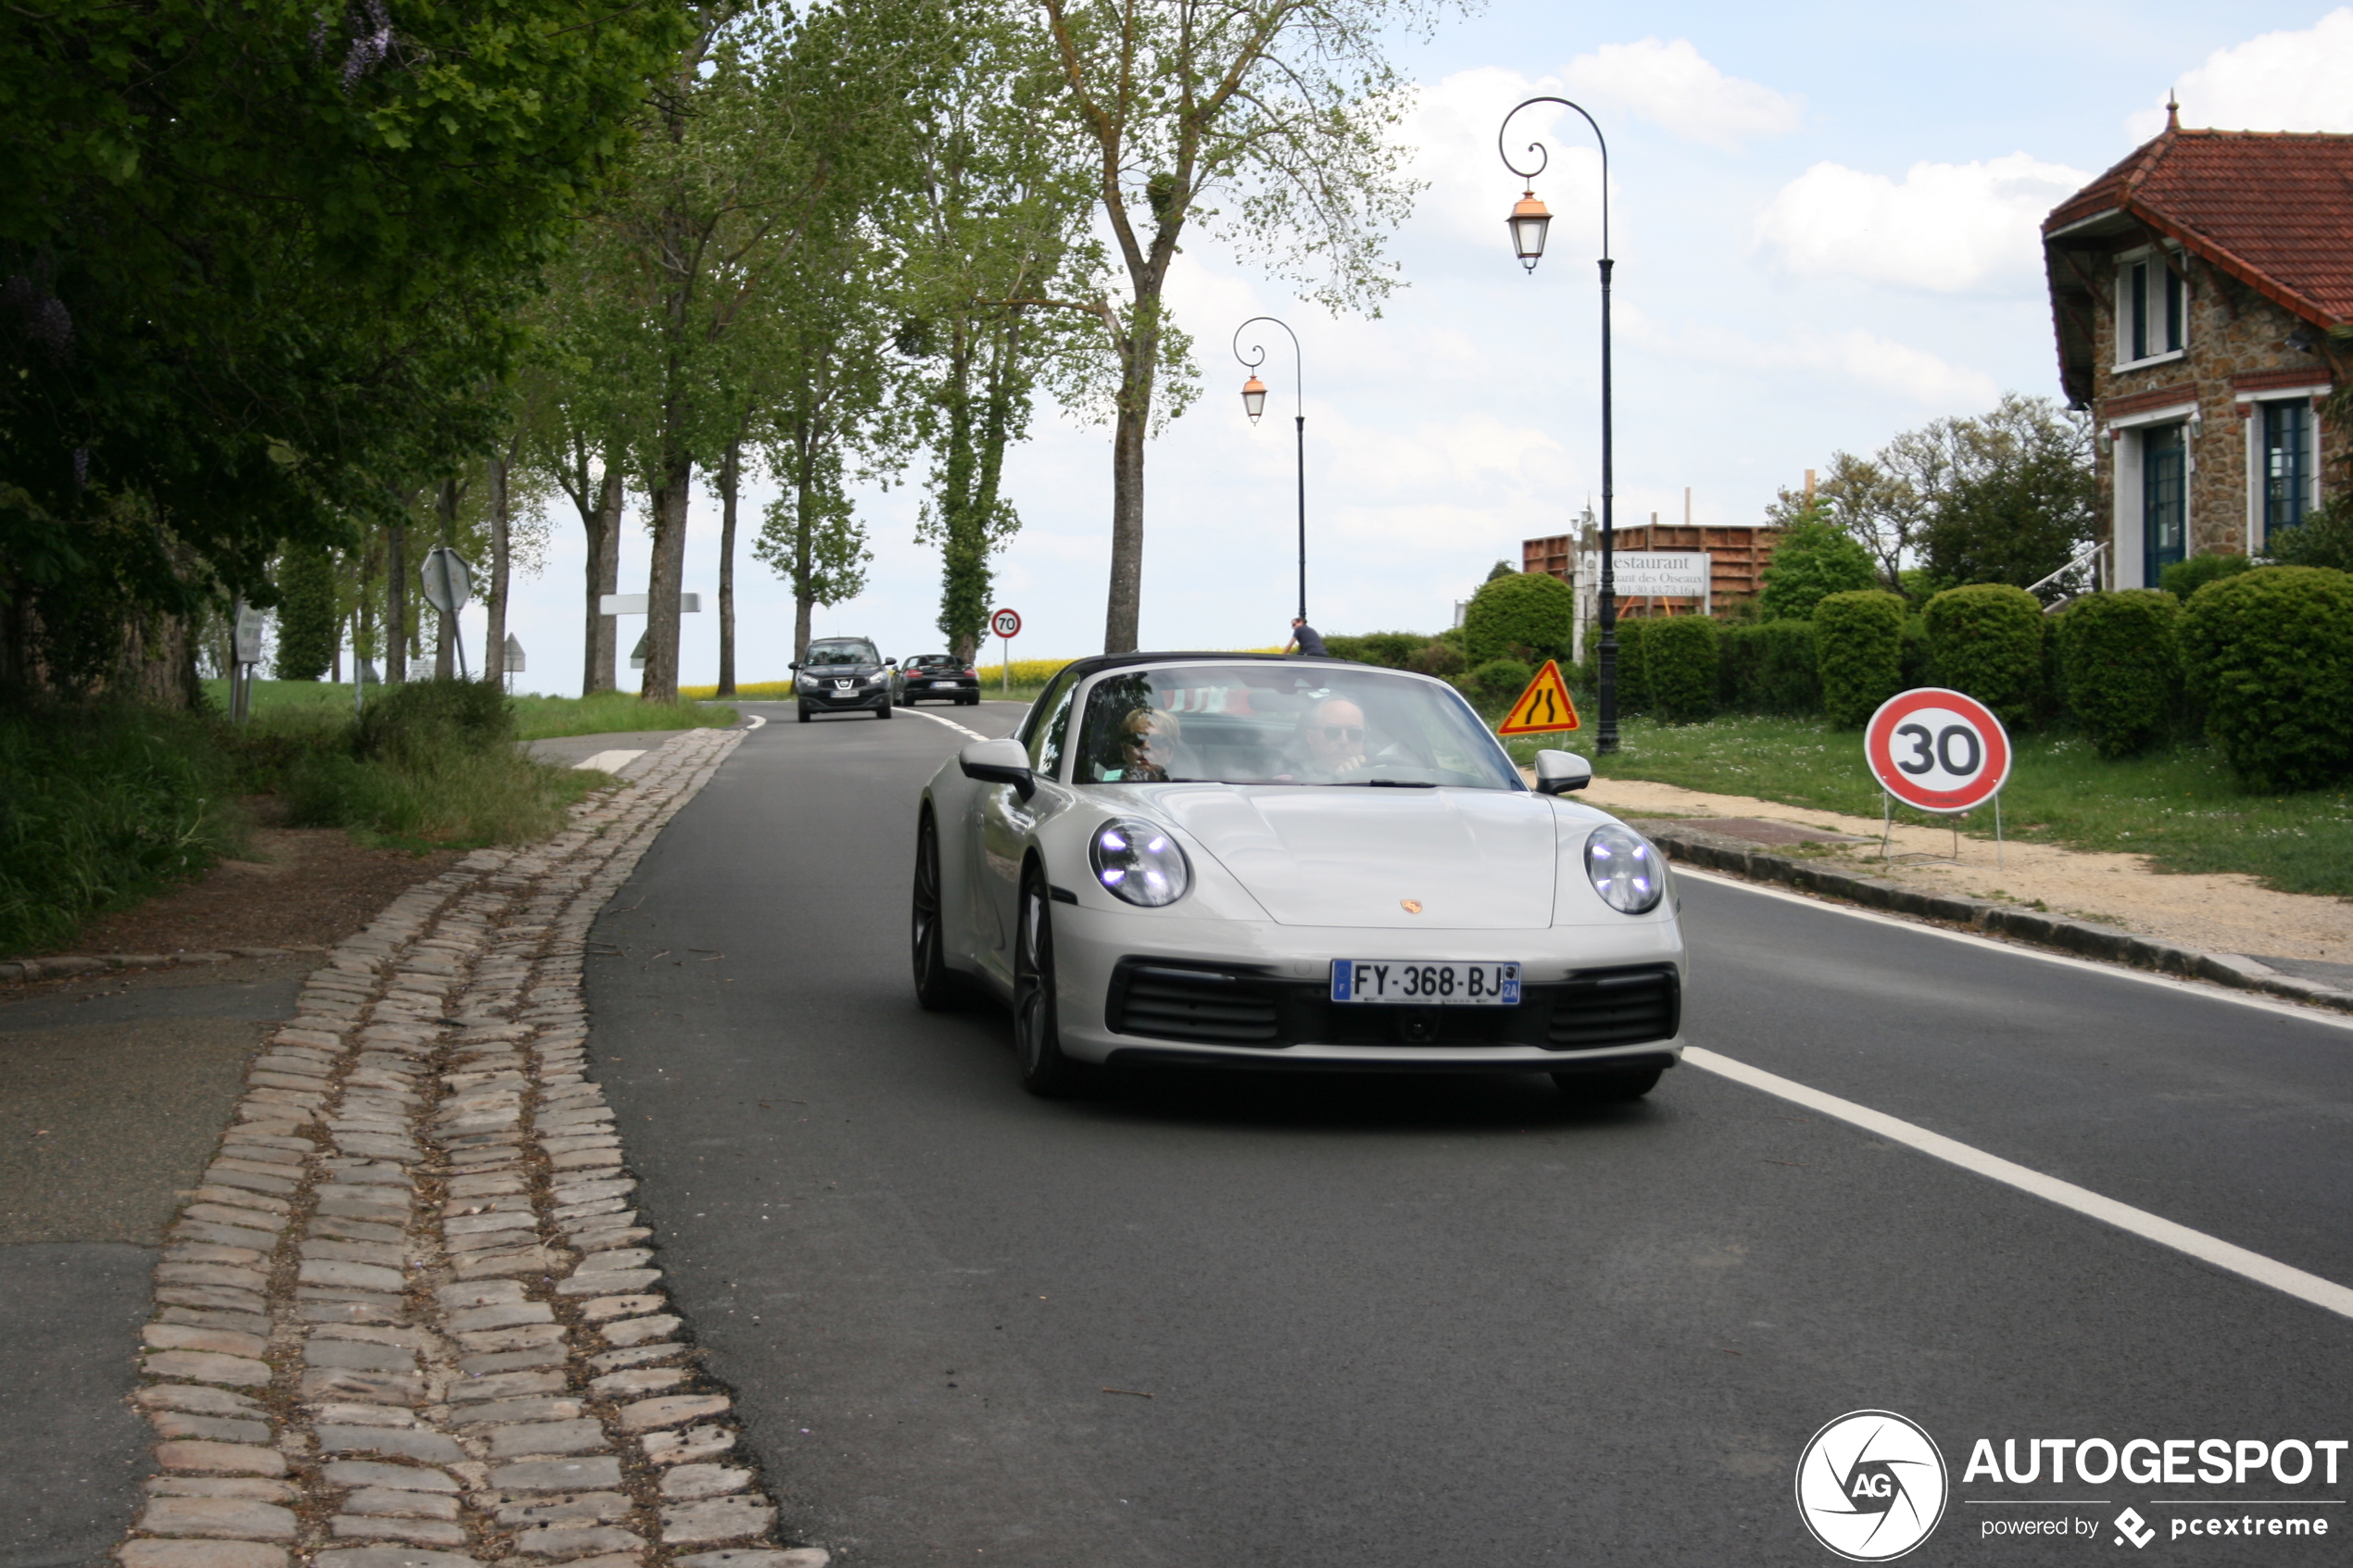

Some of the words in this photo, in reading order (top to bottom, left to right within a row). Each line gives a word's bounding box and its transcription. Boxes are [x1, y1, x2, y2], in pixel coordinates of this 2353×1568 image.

[1613, 557, 1690, 569] estaurant
[1639, 572, 1656, 583] des
[1659, 572, 1703, 583] Oiseaux
[999, 618, 1015, 630] 70
[1896, 723, 1981, 776] 30
[1339, 984, 1345, 993] F
[1354, 965, 1502, 997] FY-368-BJ
[1504, 985, 1517, 998] 2A
